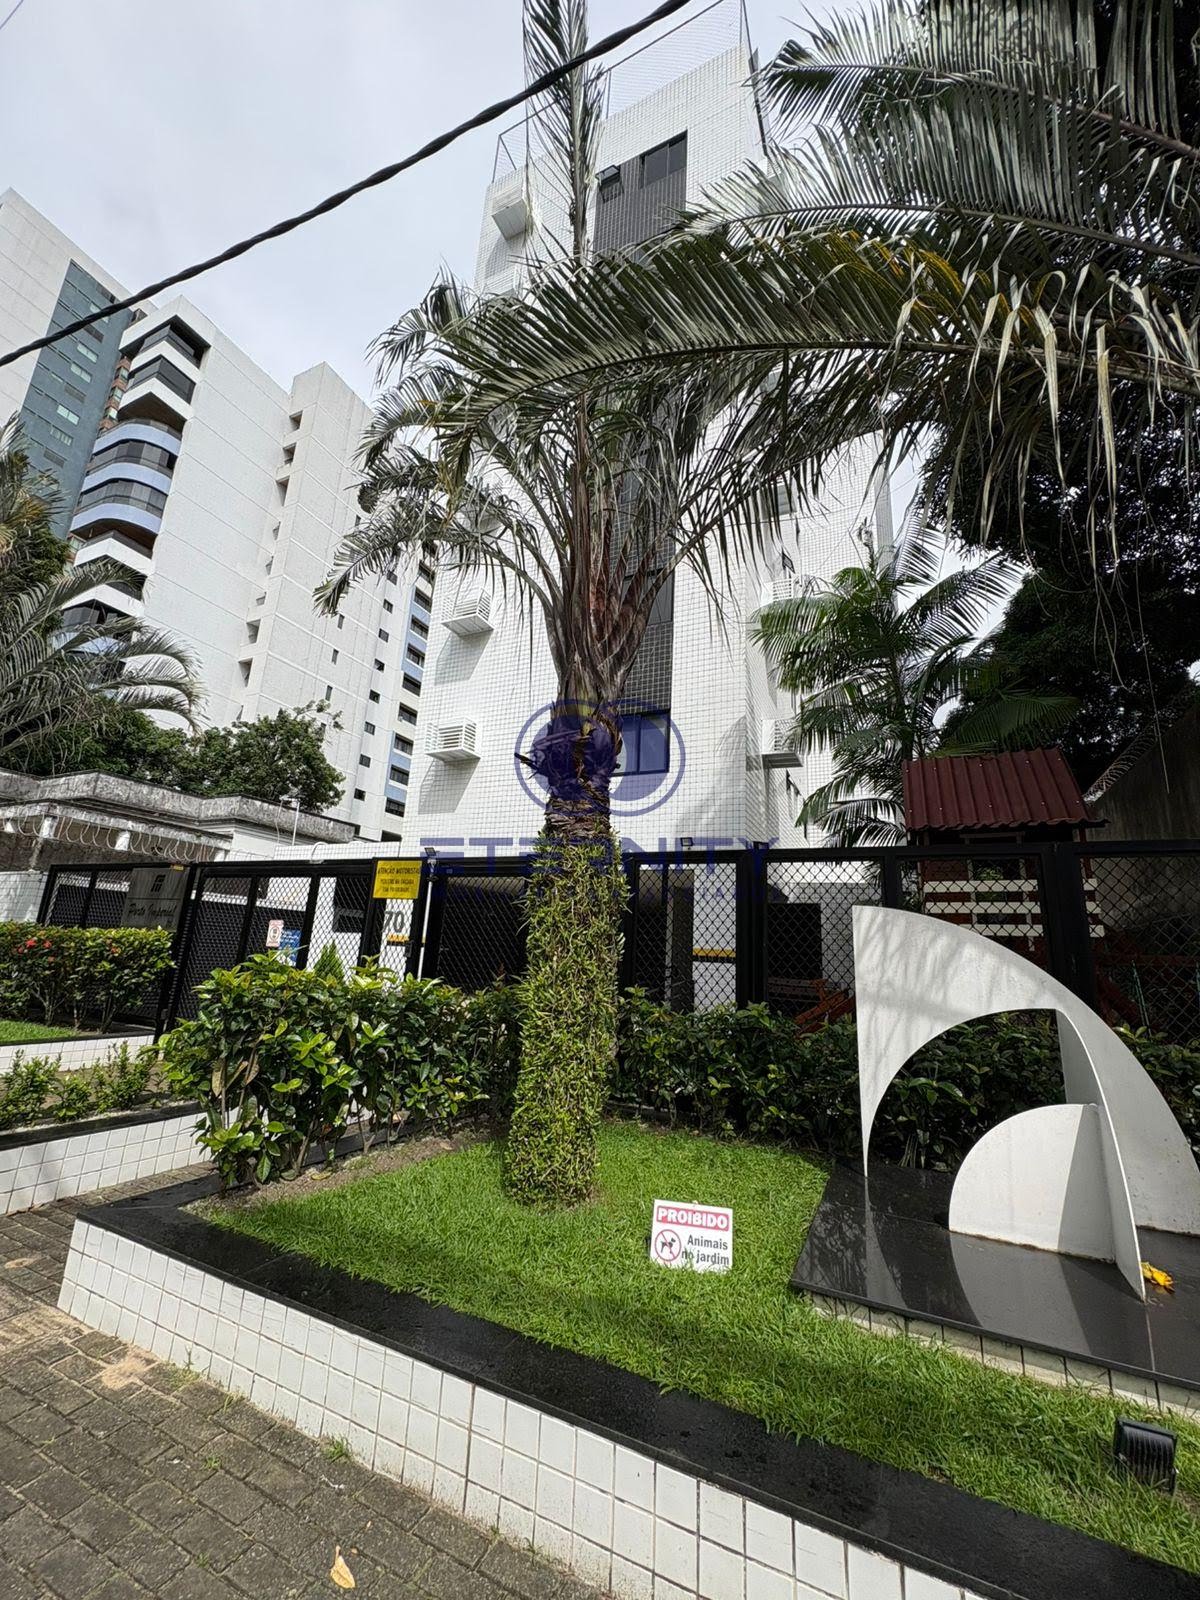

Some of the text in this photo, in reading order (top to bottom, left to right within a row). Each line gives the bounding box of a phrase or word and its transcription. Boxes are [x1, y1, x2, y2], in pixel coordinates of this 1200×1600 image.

[383, 911, 405, 933] 70
[658, 1208, 728, 1229] PROIBIDO
[687, 1234, 728, 1250] Animais
[681, 1249, 730, 1265] no jardim
